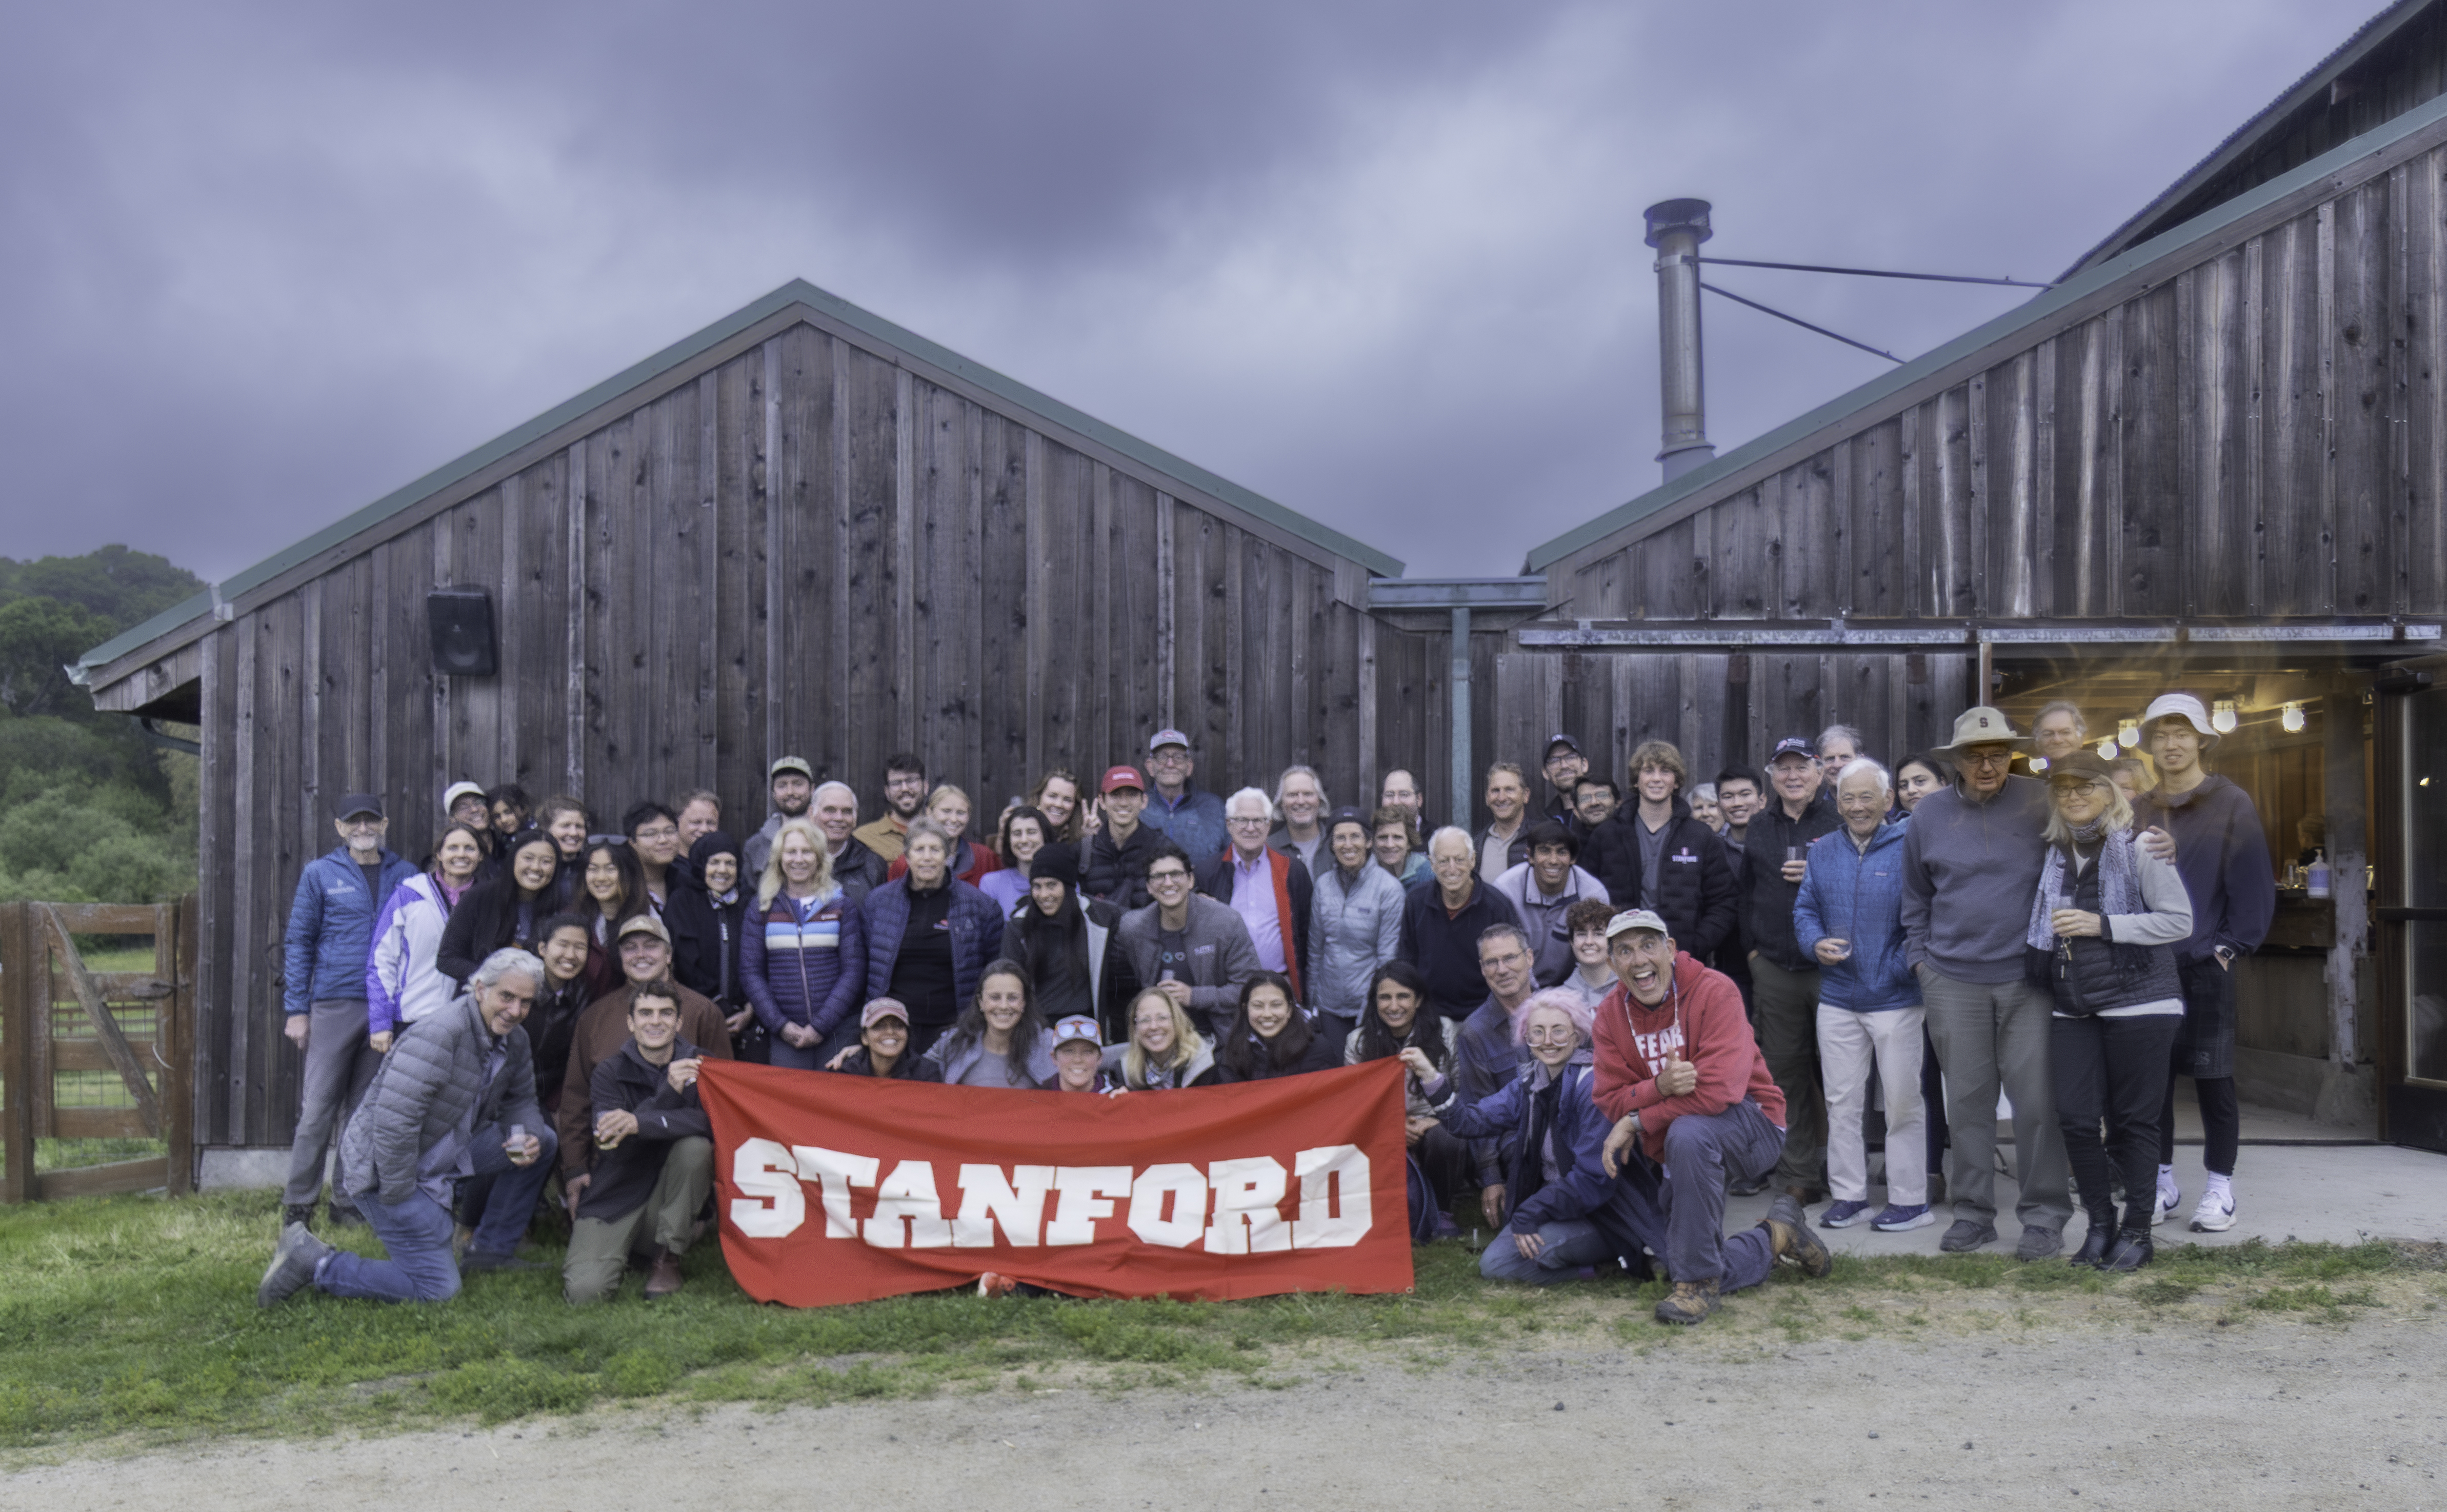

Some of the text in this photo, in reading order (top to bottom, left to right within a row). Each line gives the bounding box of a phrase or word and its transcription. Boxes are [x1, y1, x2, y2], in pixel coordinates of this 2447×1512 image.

[1980, 717, 1988, 728] S
[1634, 1026, 1684, 1058] FEAR
[730, 1137, 1373, 1255] STANFORD
